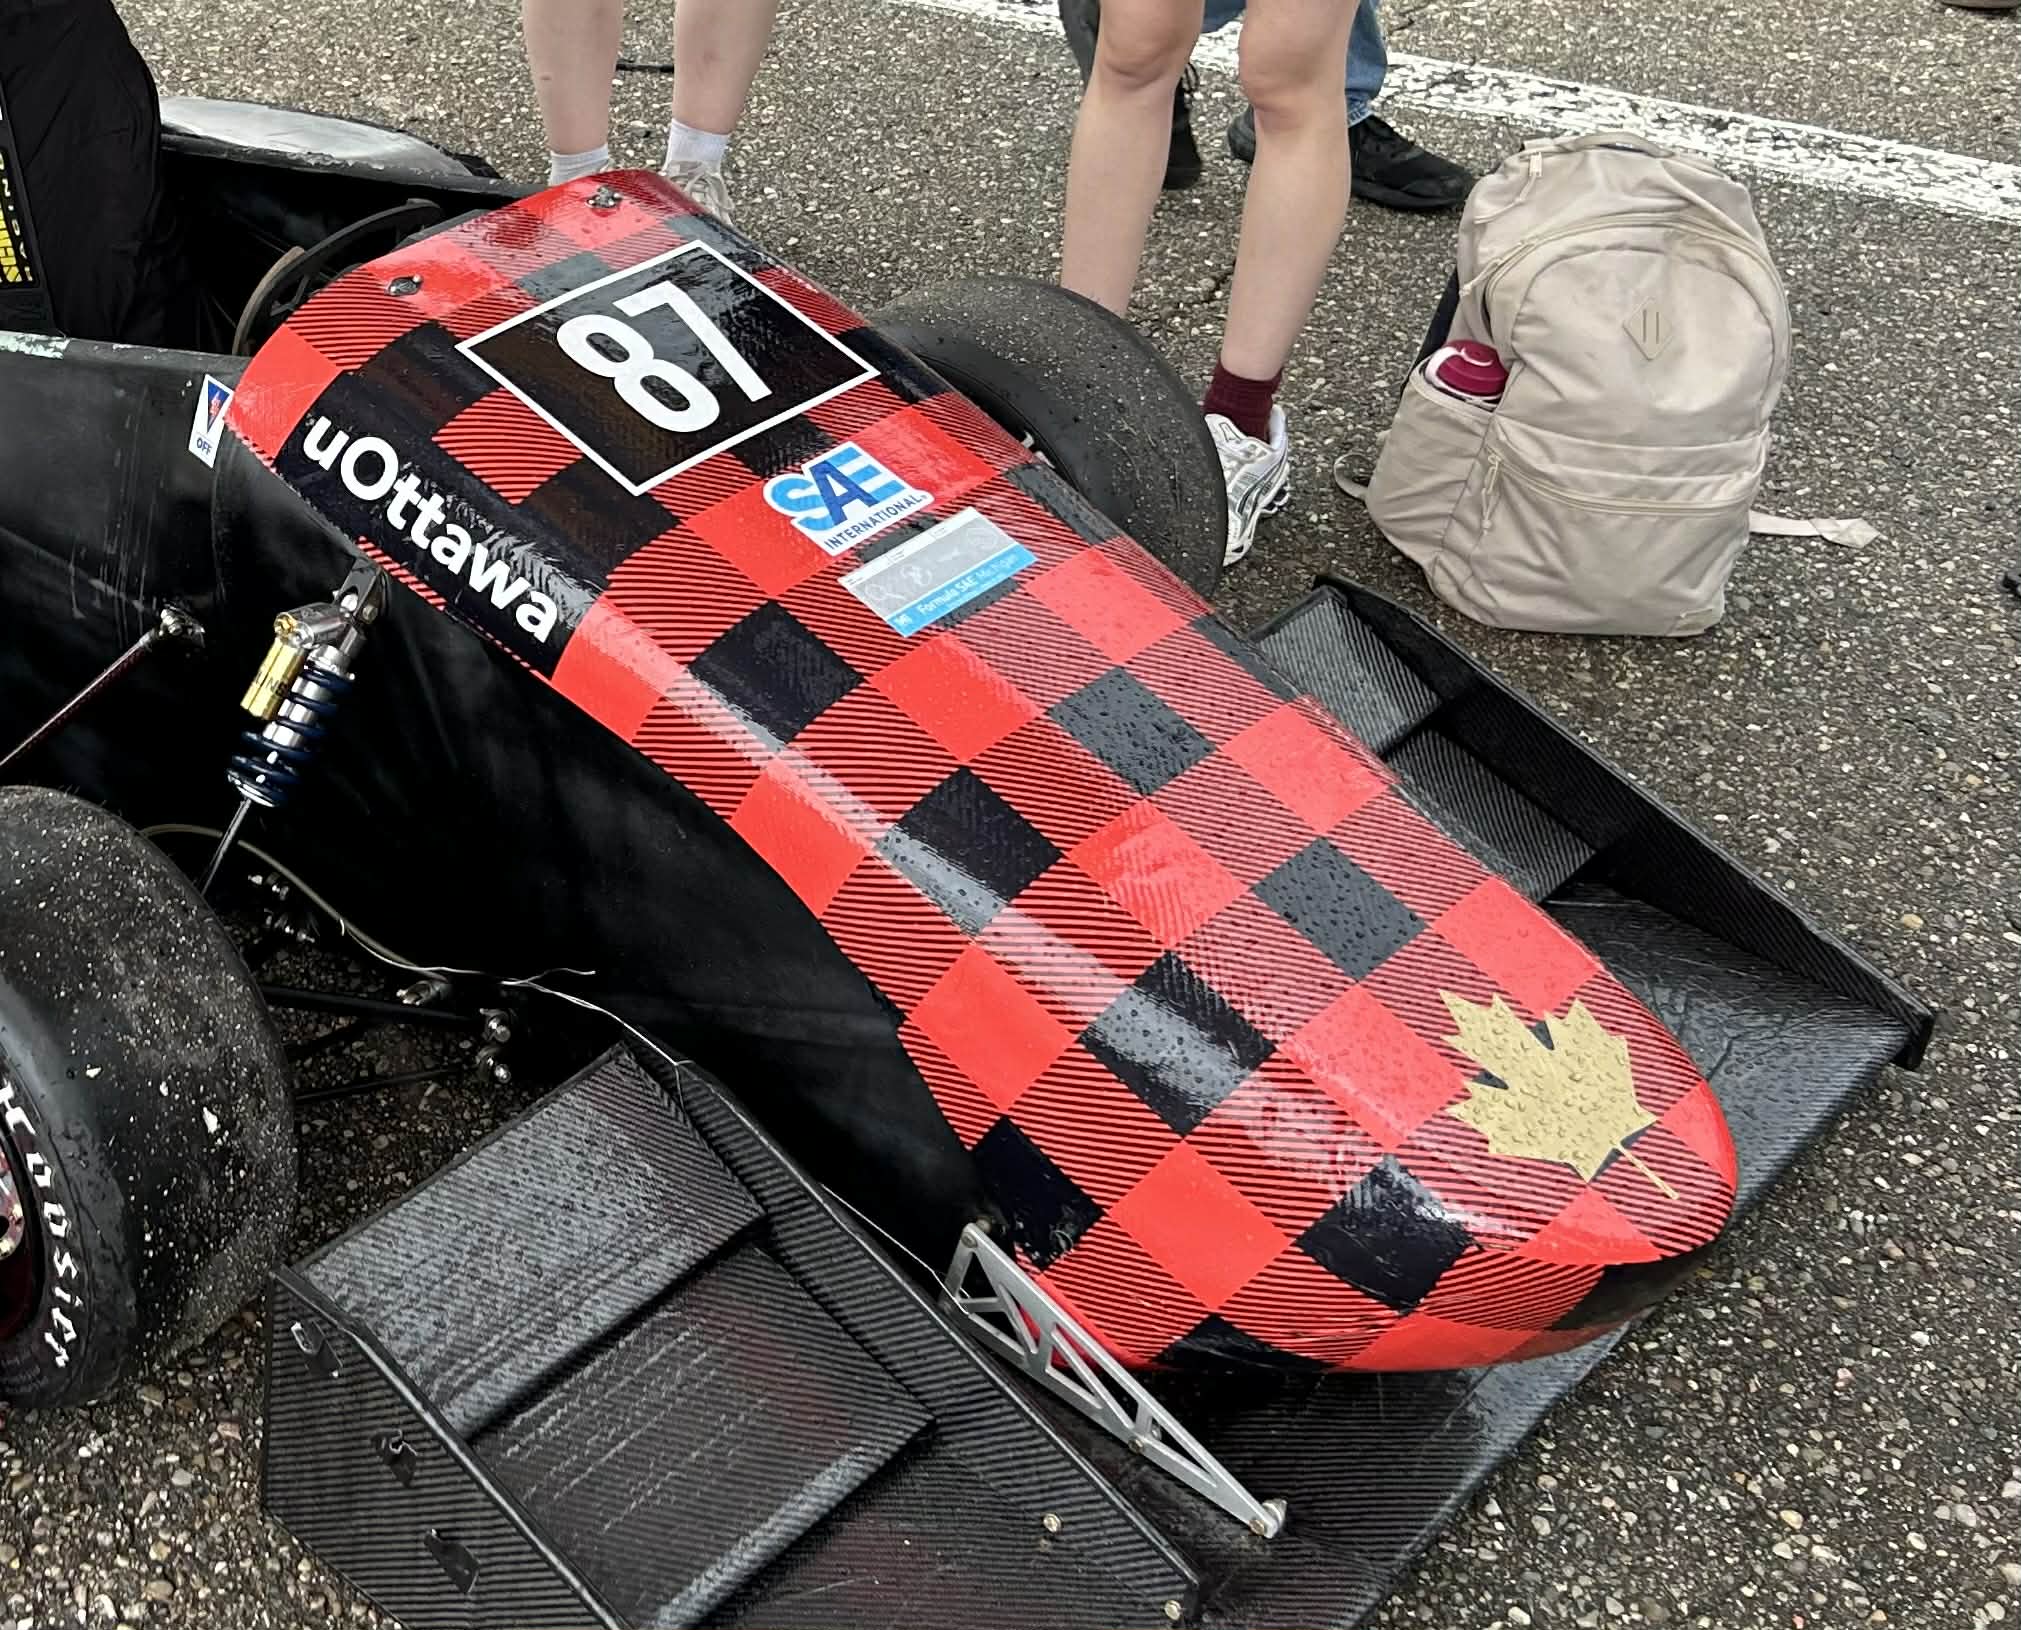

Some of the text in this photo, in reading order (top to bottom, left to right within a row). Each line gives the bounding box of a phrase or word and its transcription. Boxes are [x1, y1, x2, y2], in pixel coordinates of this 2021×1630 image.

[556, 280, 772, 433] 87
[196, 437, 213, 455] OFF
[771, 446, 906, 531] SAE
[824, 493, 923, 550] INTERNATIONAL
[303, 415, 558, 643] uOttawa
[917, 587, 957, 615] Formula
[955, 576, 978, 593] SAE
